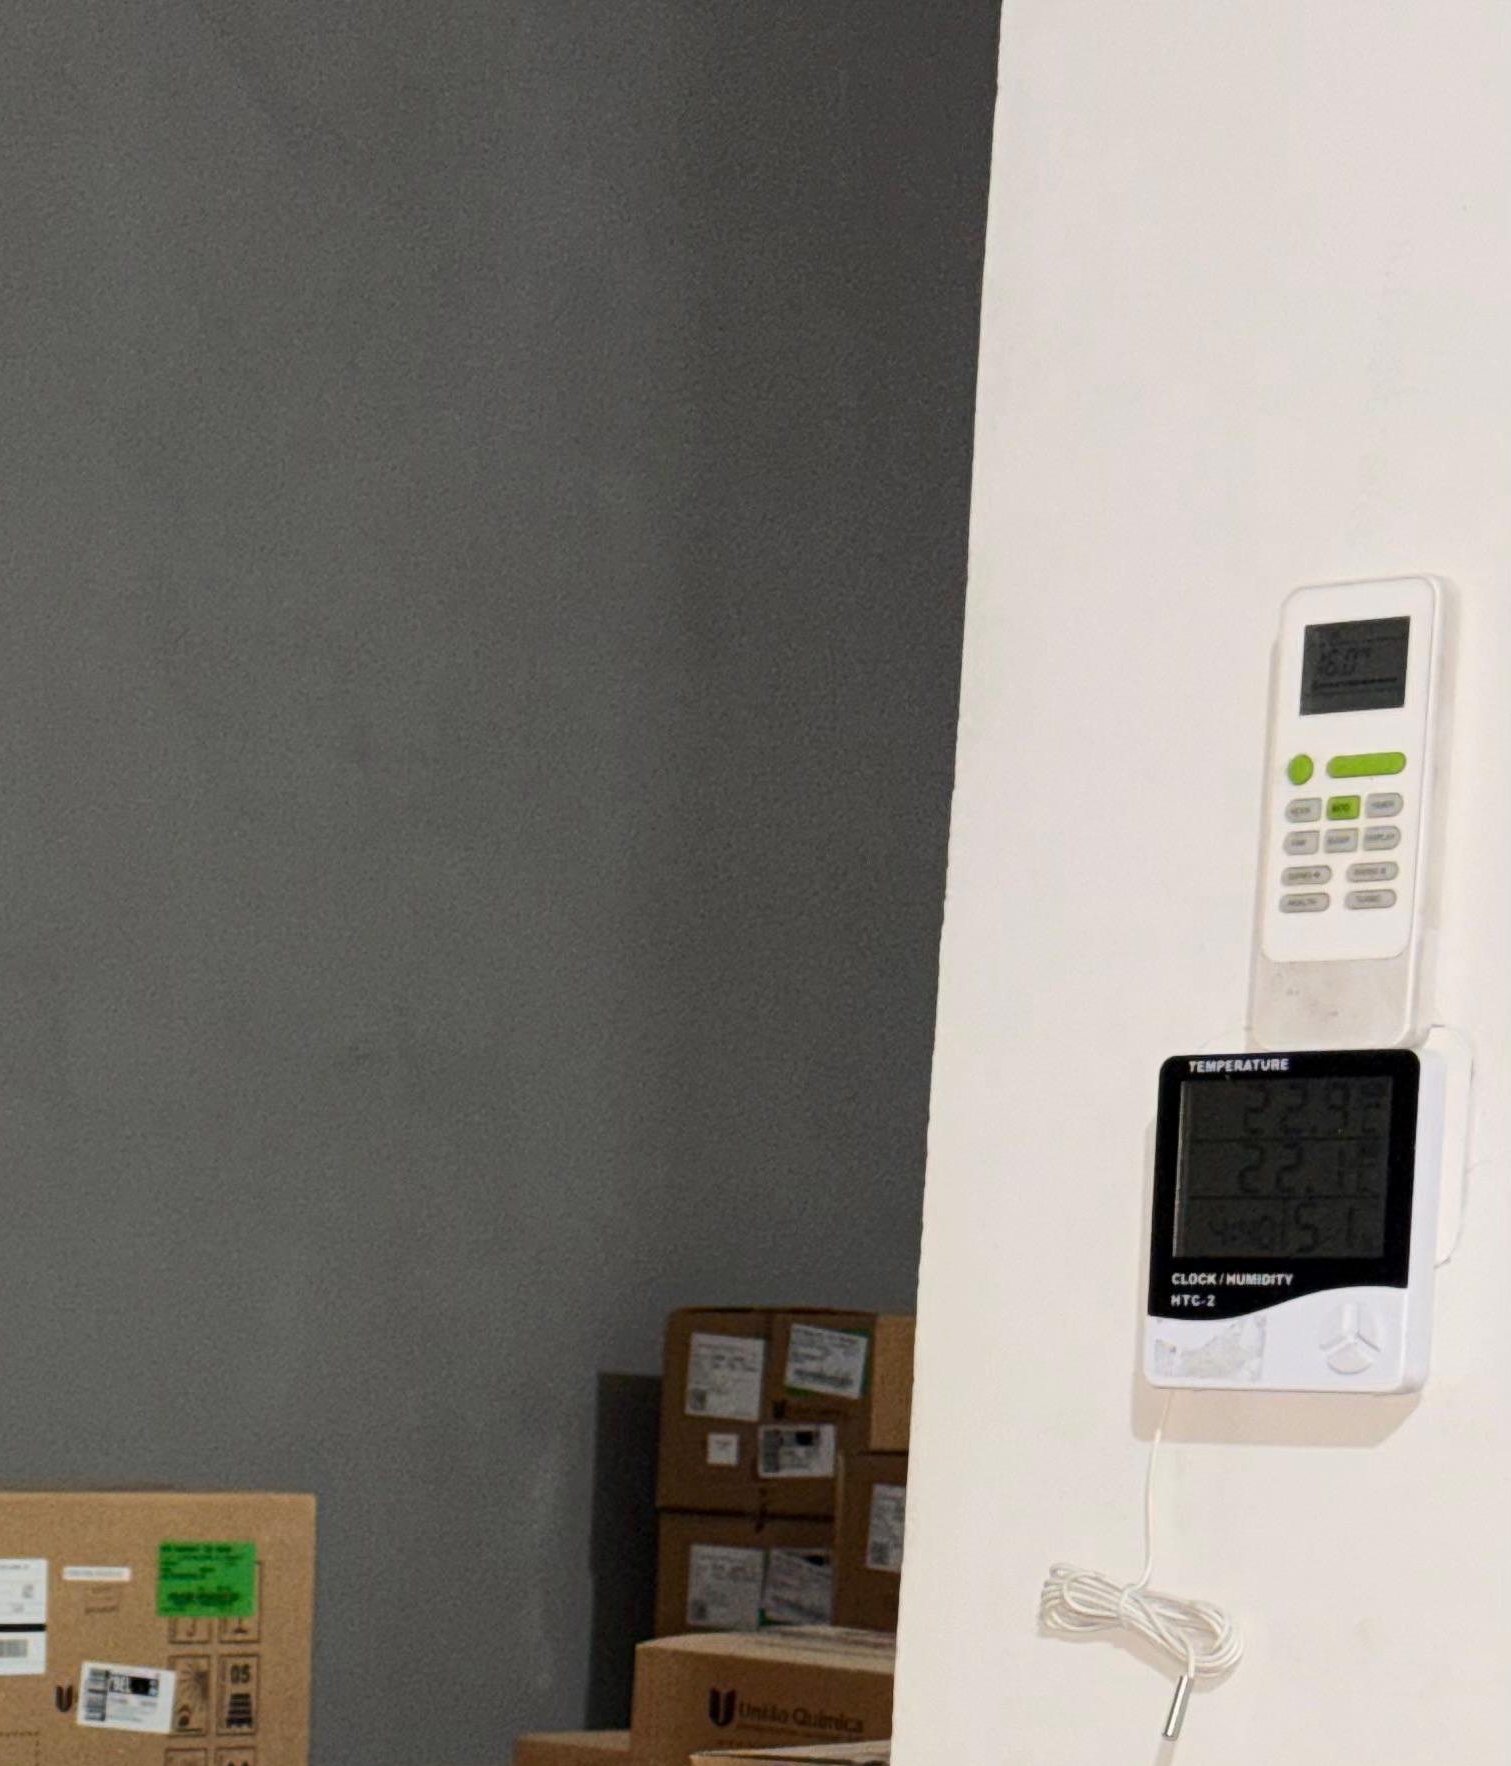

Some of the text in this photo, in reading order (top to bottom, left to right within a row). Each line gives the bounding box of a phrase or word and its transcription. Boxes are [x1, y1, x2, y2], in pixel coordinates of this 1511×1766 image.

[1189, 1058, 1290, 1073] TEMPERATURE
[1171, 1273, 1217, 1285] CLOCK
[1226, 1273, 1294, 1285] HUMIDITY
[791, 1708, 864, 1733] Química
